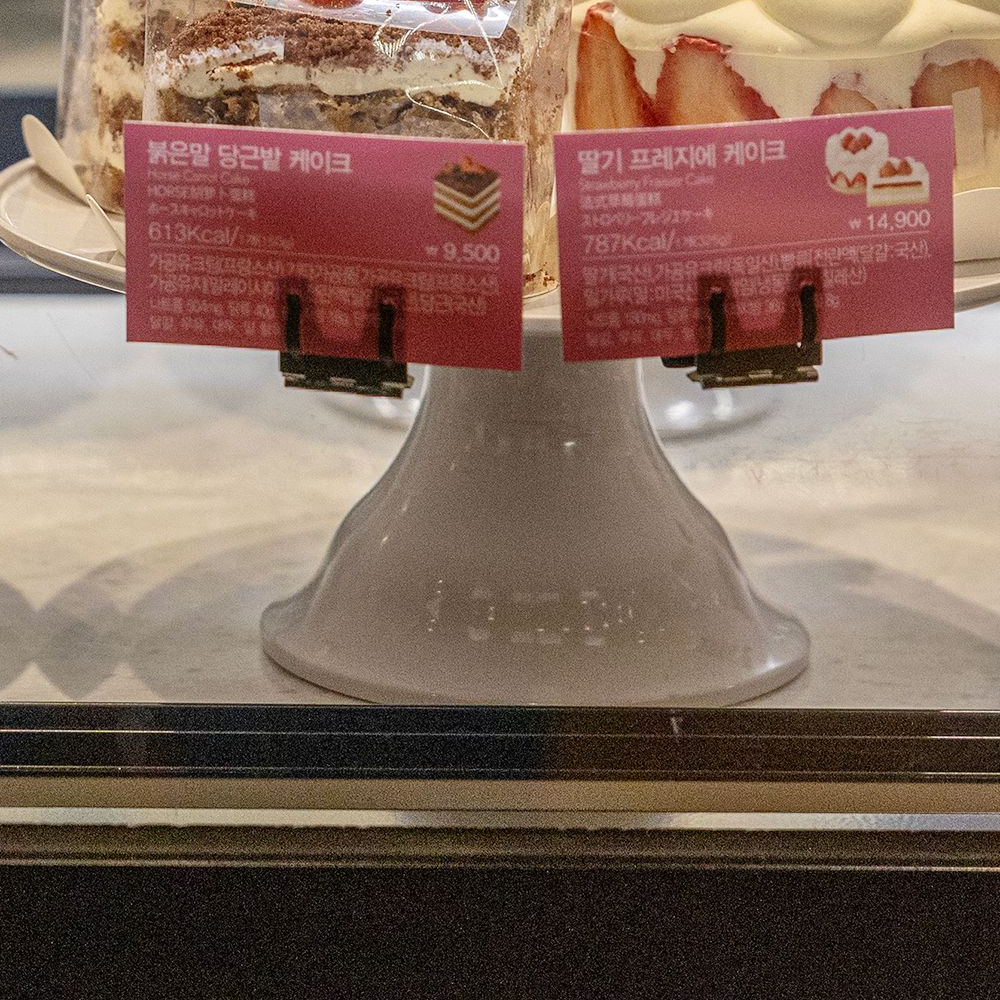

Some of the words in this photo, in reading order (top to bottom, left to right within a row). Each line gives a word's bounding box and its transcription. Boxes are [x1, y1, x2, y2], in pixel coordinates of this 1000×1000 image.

[147, 140, 211, 168] 붉은말
[217, 145, 283, 173] 당근밭
[288, 149, 353, 176] 케이크
[577, 146, 624, 176] 딸기
[631, 143, 717, 172] 프레지에
[723, 139, 787, 165] 케이크
[866, 208, 932, 233] 14,900
[442, 242, 500, 266] 9,500
